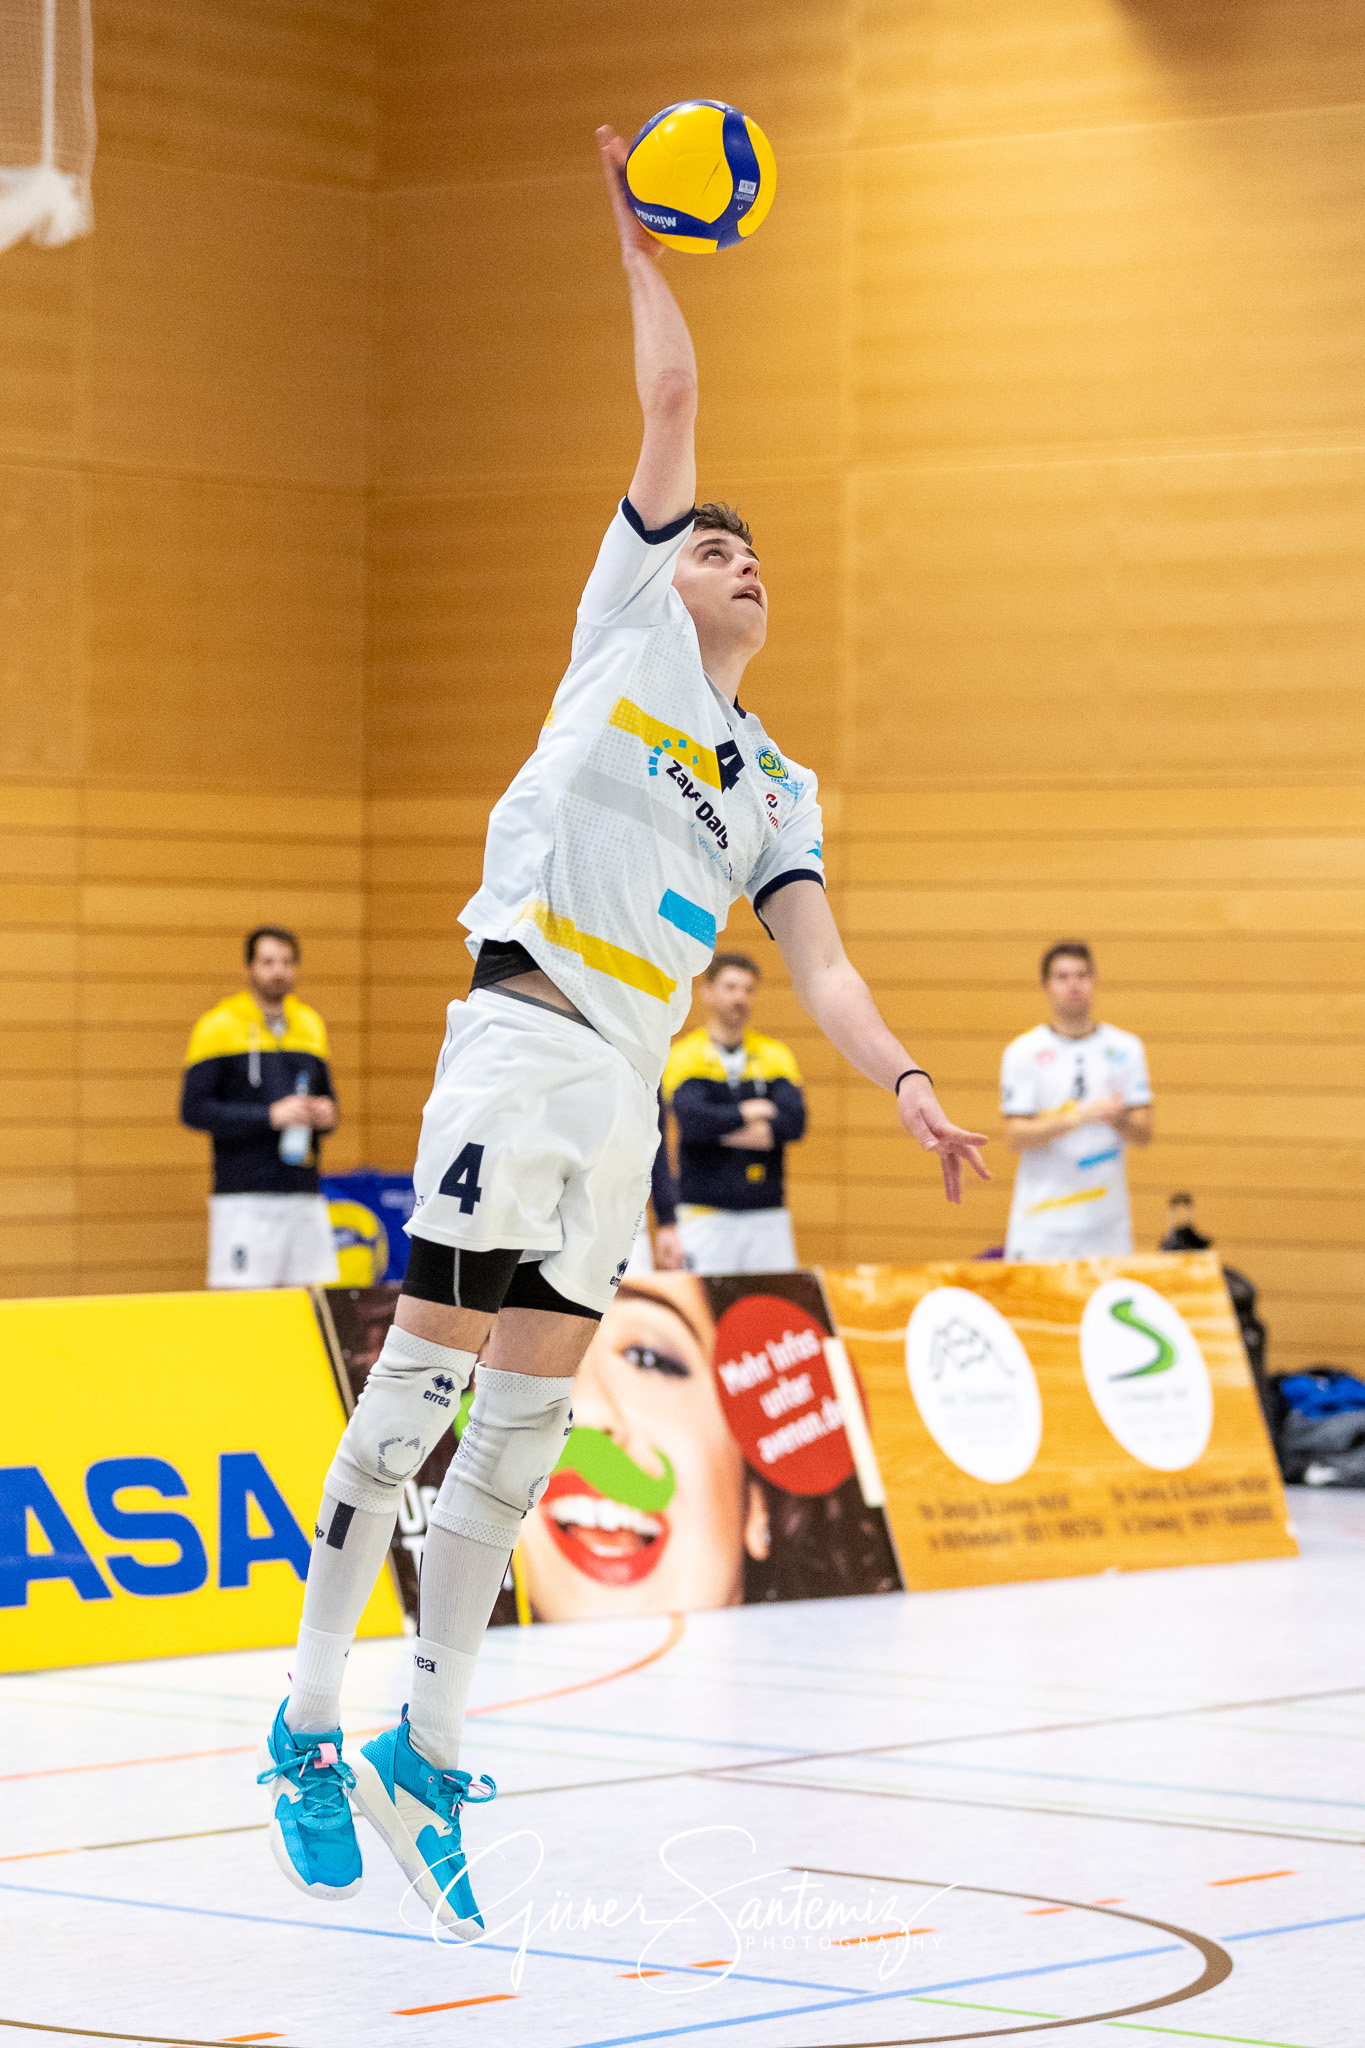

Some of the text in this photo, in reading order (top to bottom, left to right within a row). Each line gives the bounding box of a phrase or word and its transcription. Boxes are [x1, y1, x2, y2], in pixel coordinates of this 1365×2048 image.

[715, 739, 745, 794] 4
[438, 1142, 485, 1215] 4
[719, 1330, 821, 1396] Mehr Infos
[423, 1390, 451, 1408] errea
[759, 1374, 814, 1419] unter
